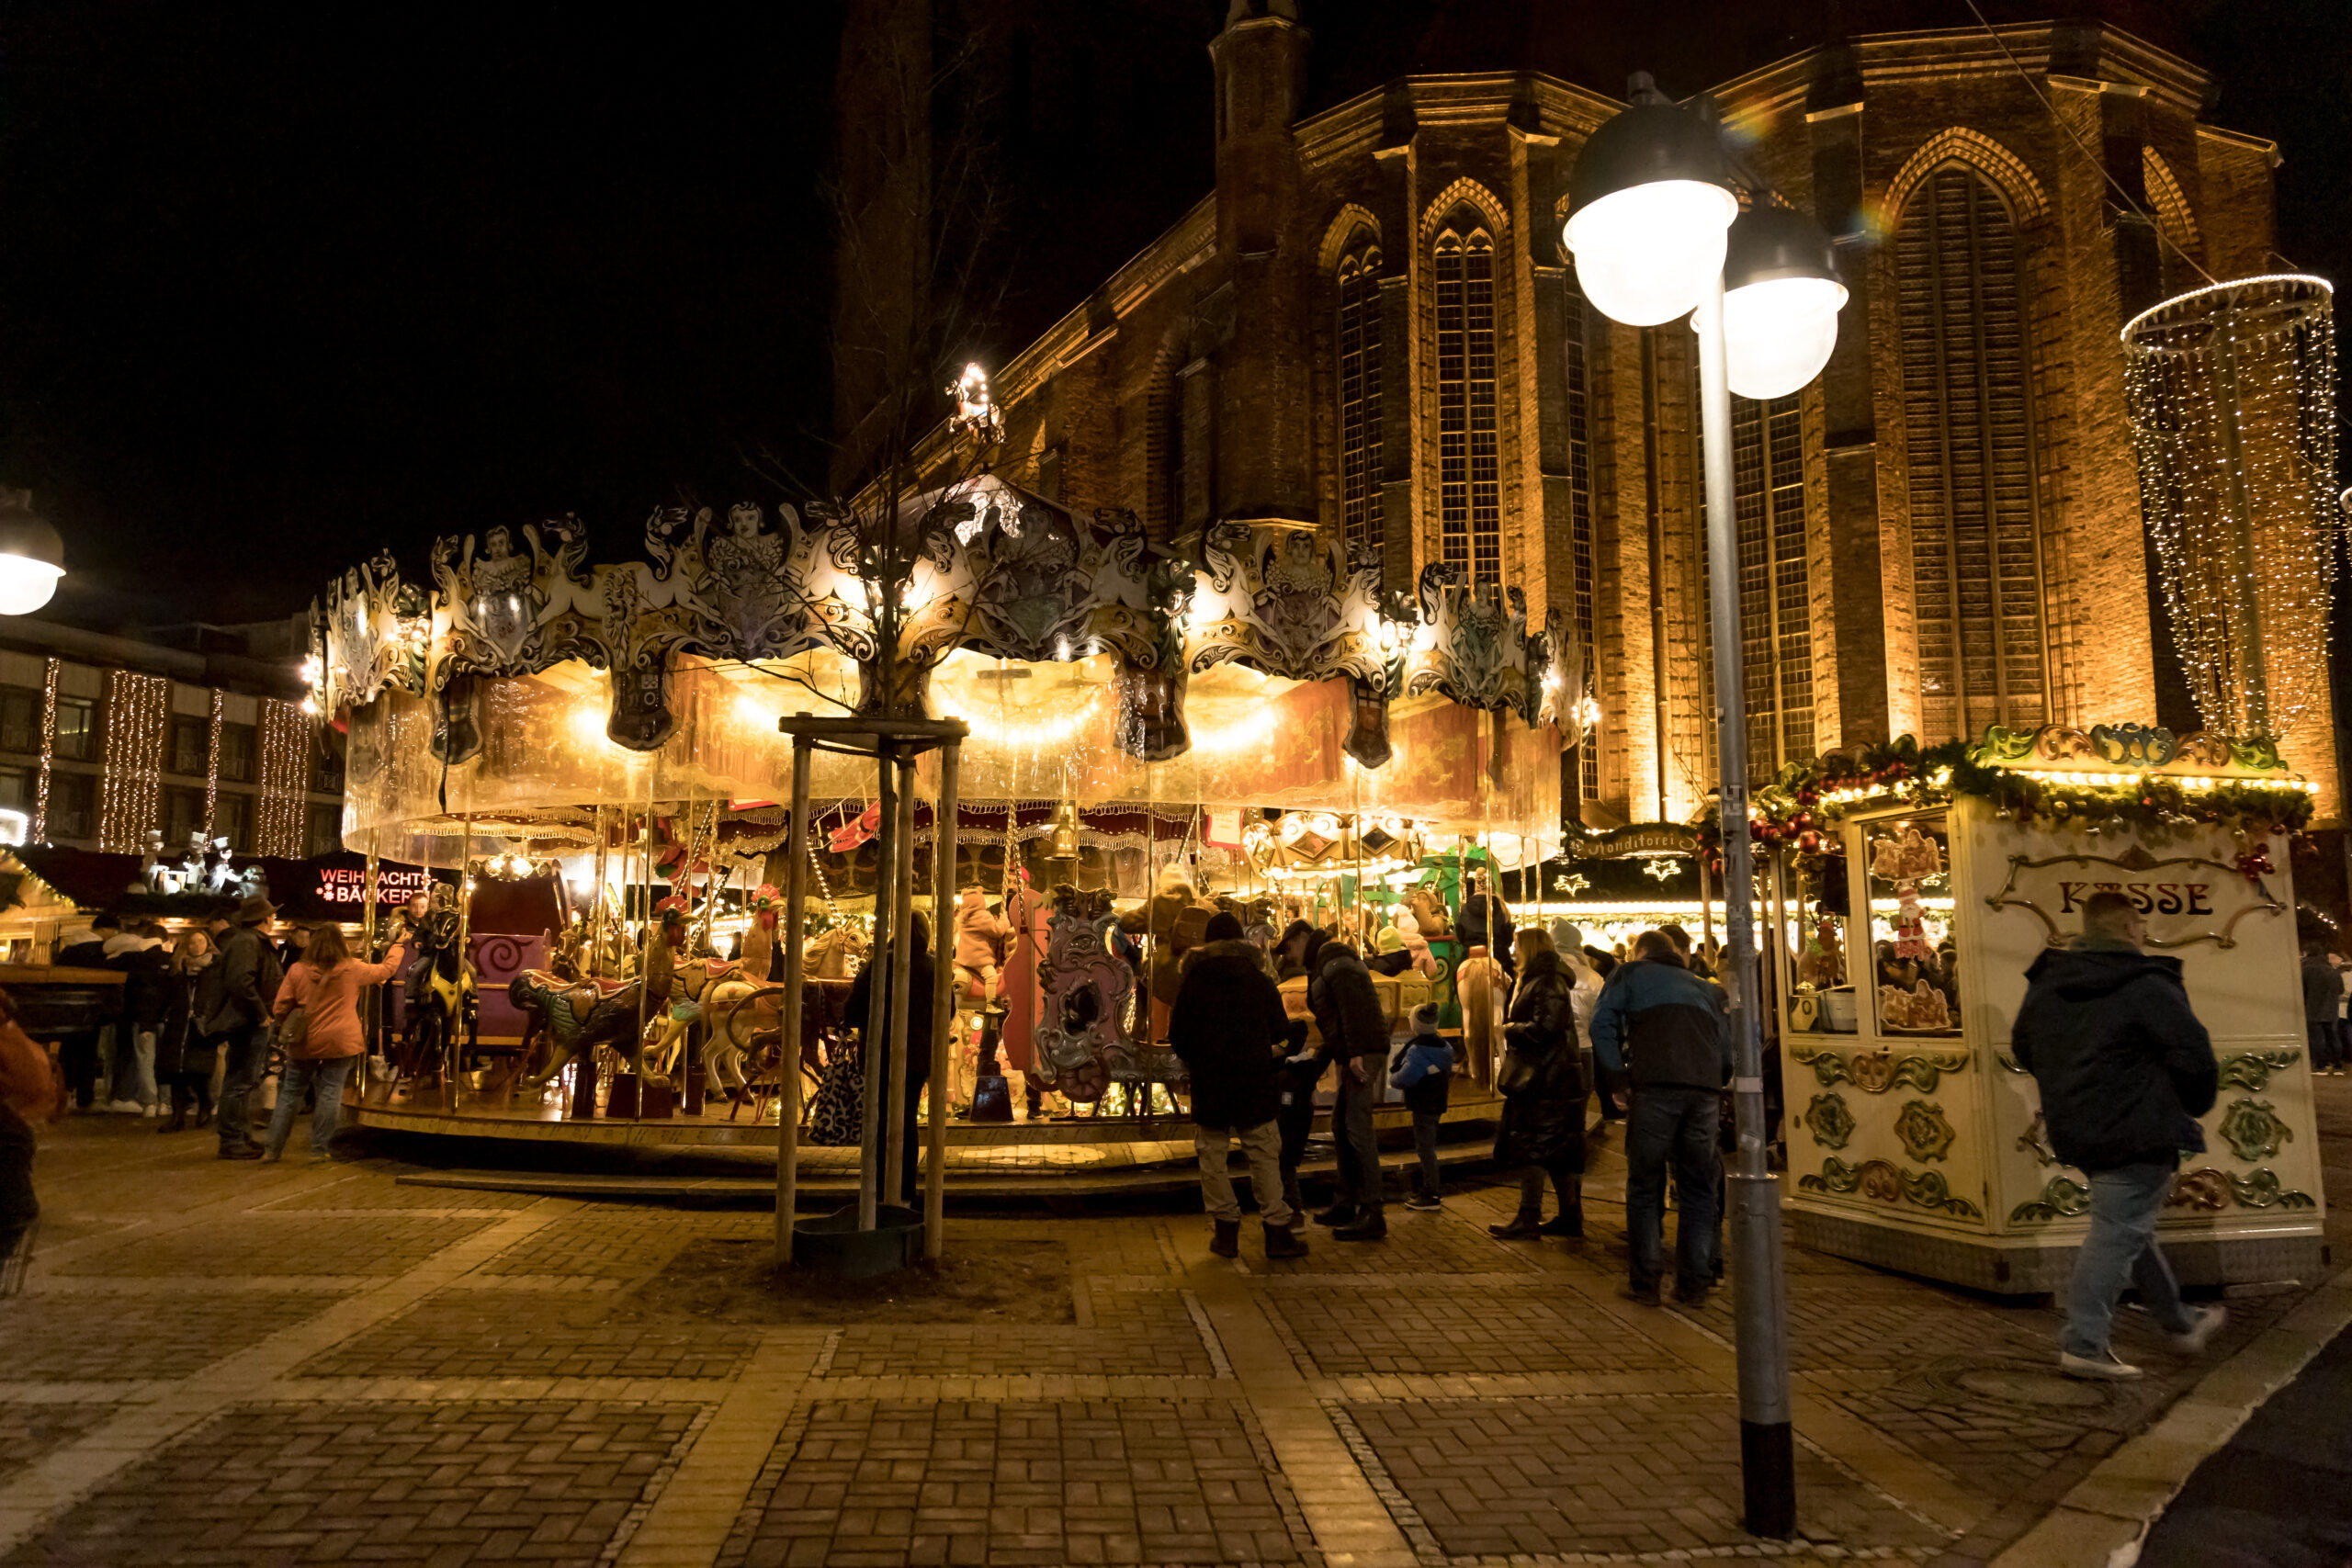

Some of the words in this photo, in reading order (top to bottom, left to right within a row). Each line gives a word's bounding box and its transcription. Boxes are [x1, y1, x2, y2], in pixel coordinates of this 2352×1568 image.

[1589, 833, 1674, 855] Konditorei
[321, 868, 438, 886] WEIHACHTS-
[336, 885, 431, 904] BÄKERI
[2059, 882, 2213, 915] KSSE
